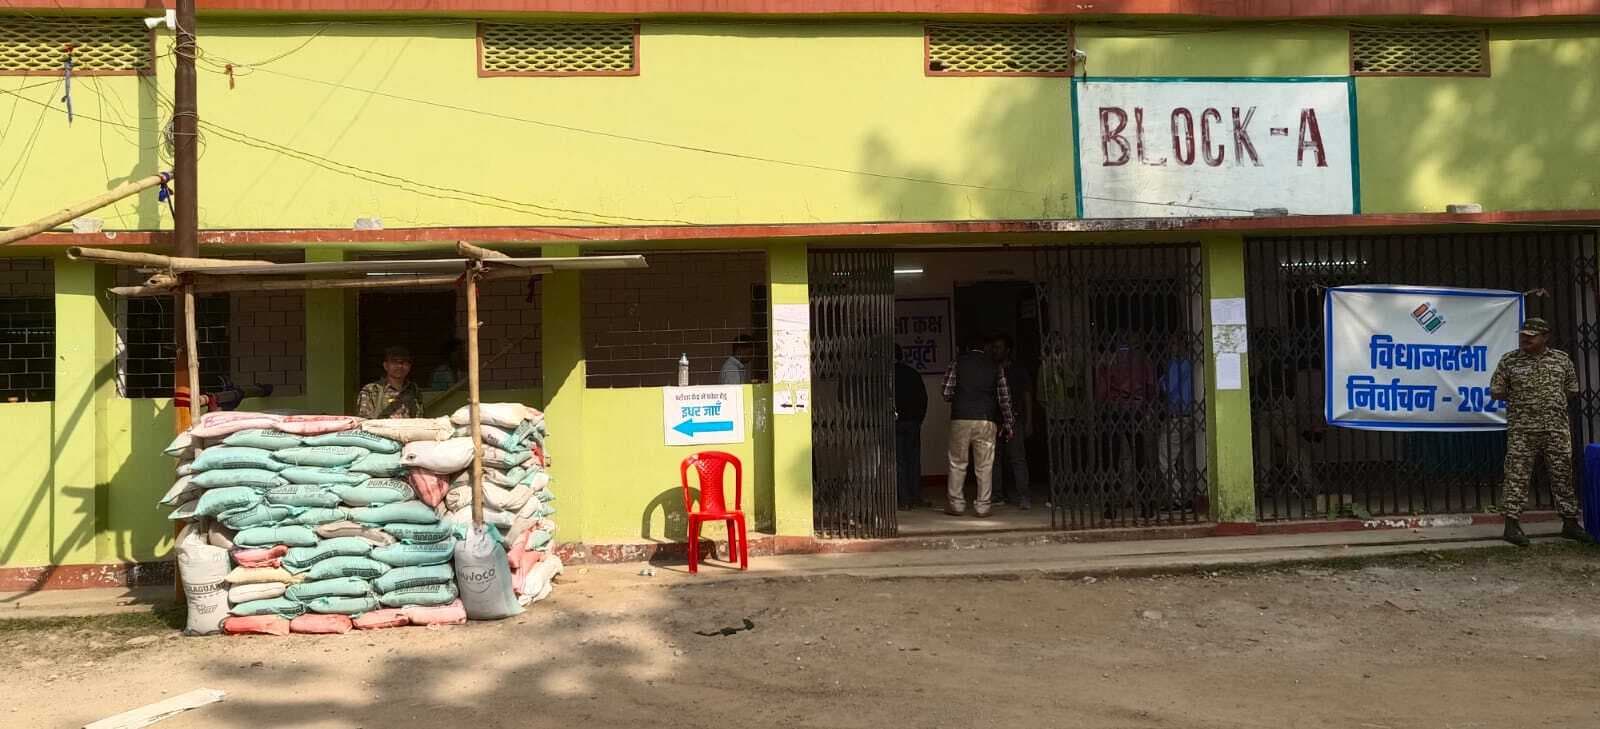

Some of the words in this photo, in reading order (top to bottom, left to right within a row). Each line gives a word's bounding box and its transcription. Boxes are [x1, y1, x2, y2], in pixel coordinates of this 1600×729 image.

[1099, 106, 1328, 167] BLOCK-A
[911, 315, 942, 334] कक्ष
[1369, 334, 1488, 371] विधानसभा
[681, 406, 701, 418] इधर
[1346, 375, 1438, 412] निर्वाचन
[1458, 386, 1506, 413] 202
